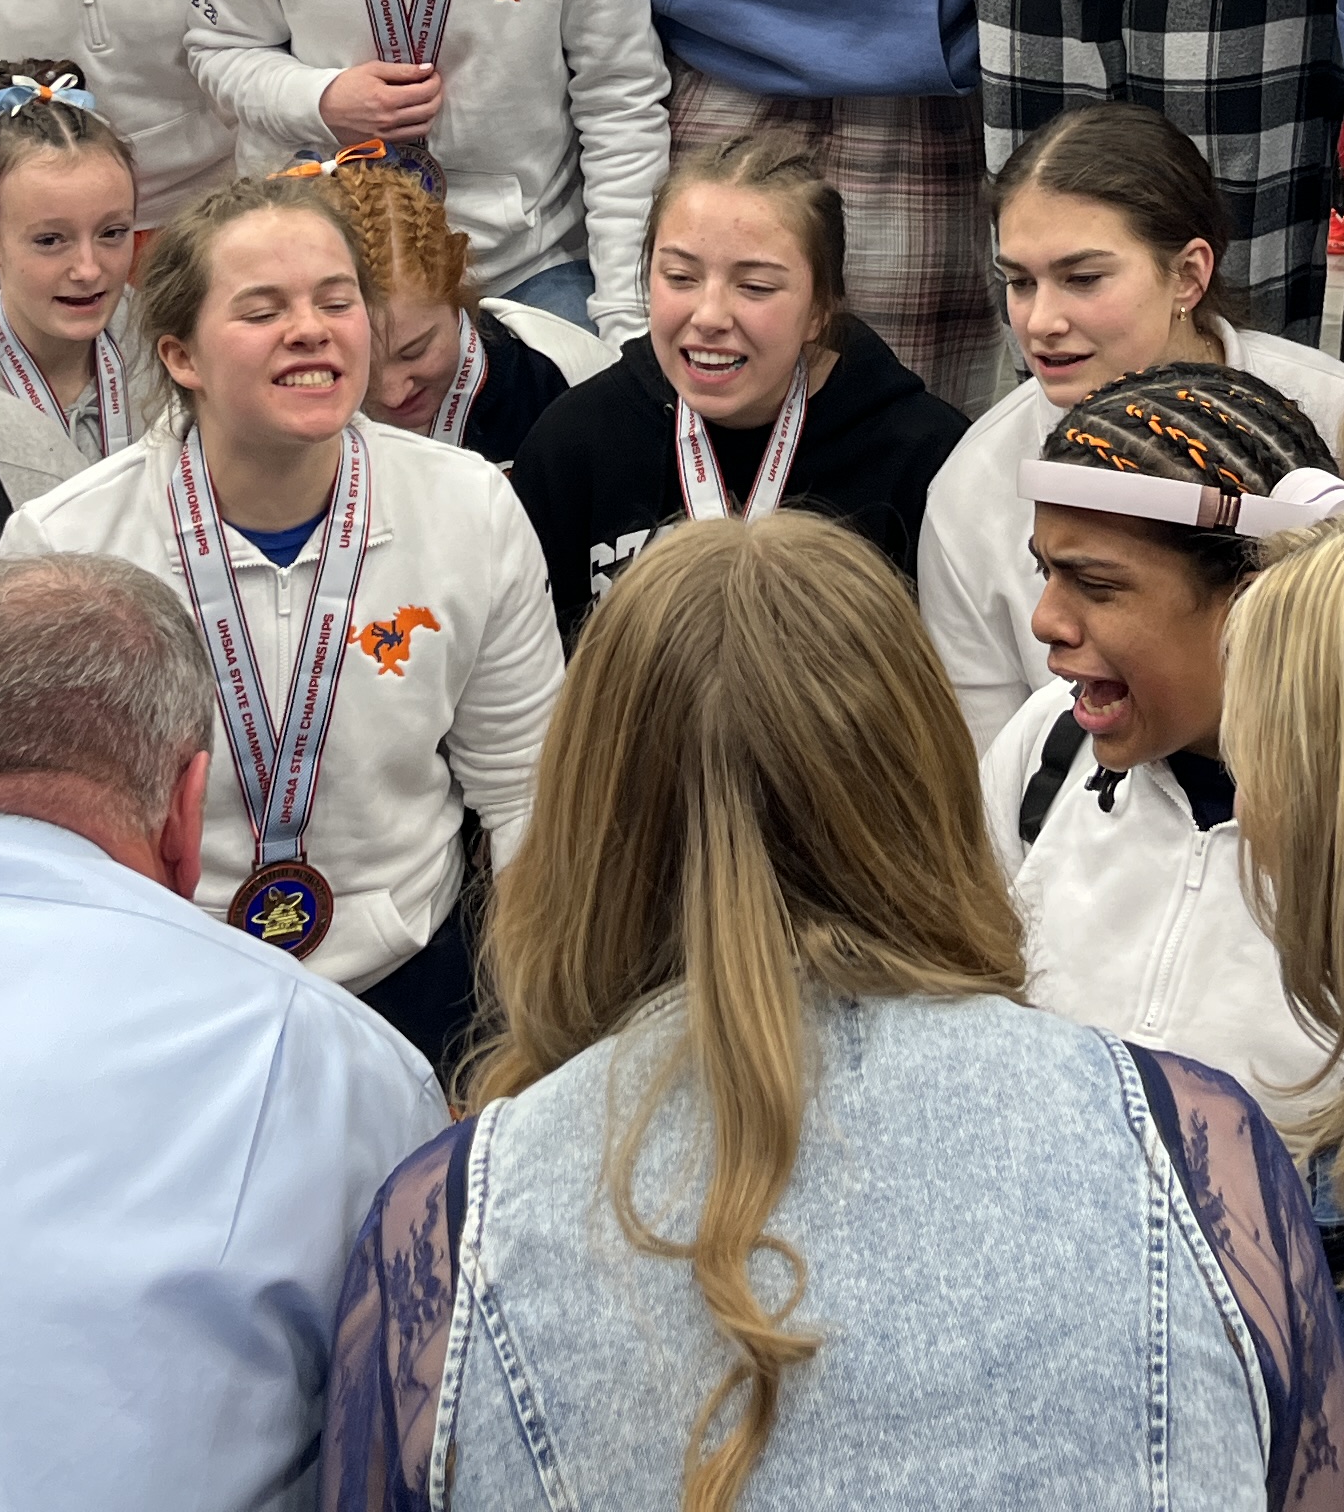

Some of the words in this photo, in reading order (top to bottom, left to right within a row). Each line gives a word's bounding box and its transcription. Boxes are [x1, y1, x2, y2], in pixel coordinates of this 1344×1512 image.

[110, 375, 120, 415] UHSAA
[443, 393, 461, 432] UHSAA
[456, 357, 474, 390] STATE
[767, 441, 785, 483] UHSAA
[339, 502, 356, 549] UHSAA
[349, 457, 361, 498] STATE
[216, 618, 237, 666] UHSAA
[229, 668, 250, 710] STATE
[299, 613, 335, 731] CHAMPIONSHIPS
[290, 734, 309, 774] STATE
[280, 777, 299, 824] UHSAA
